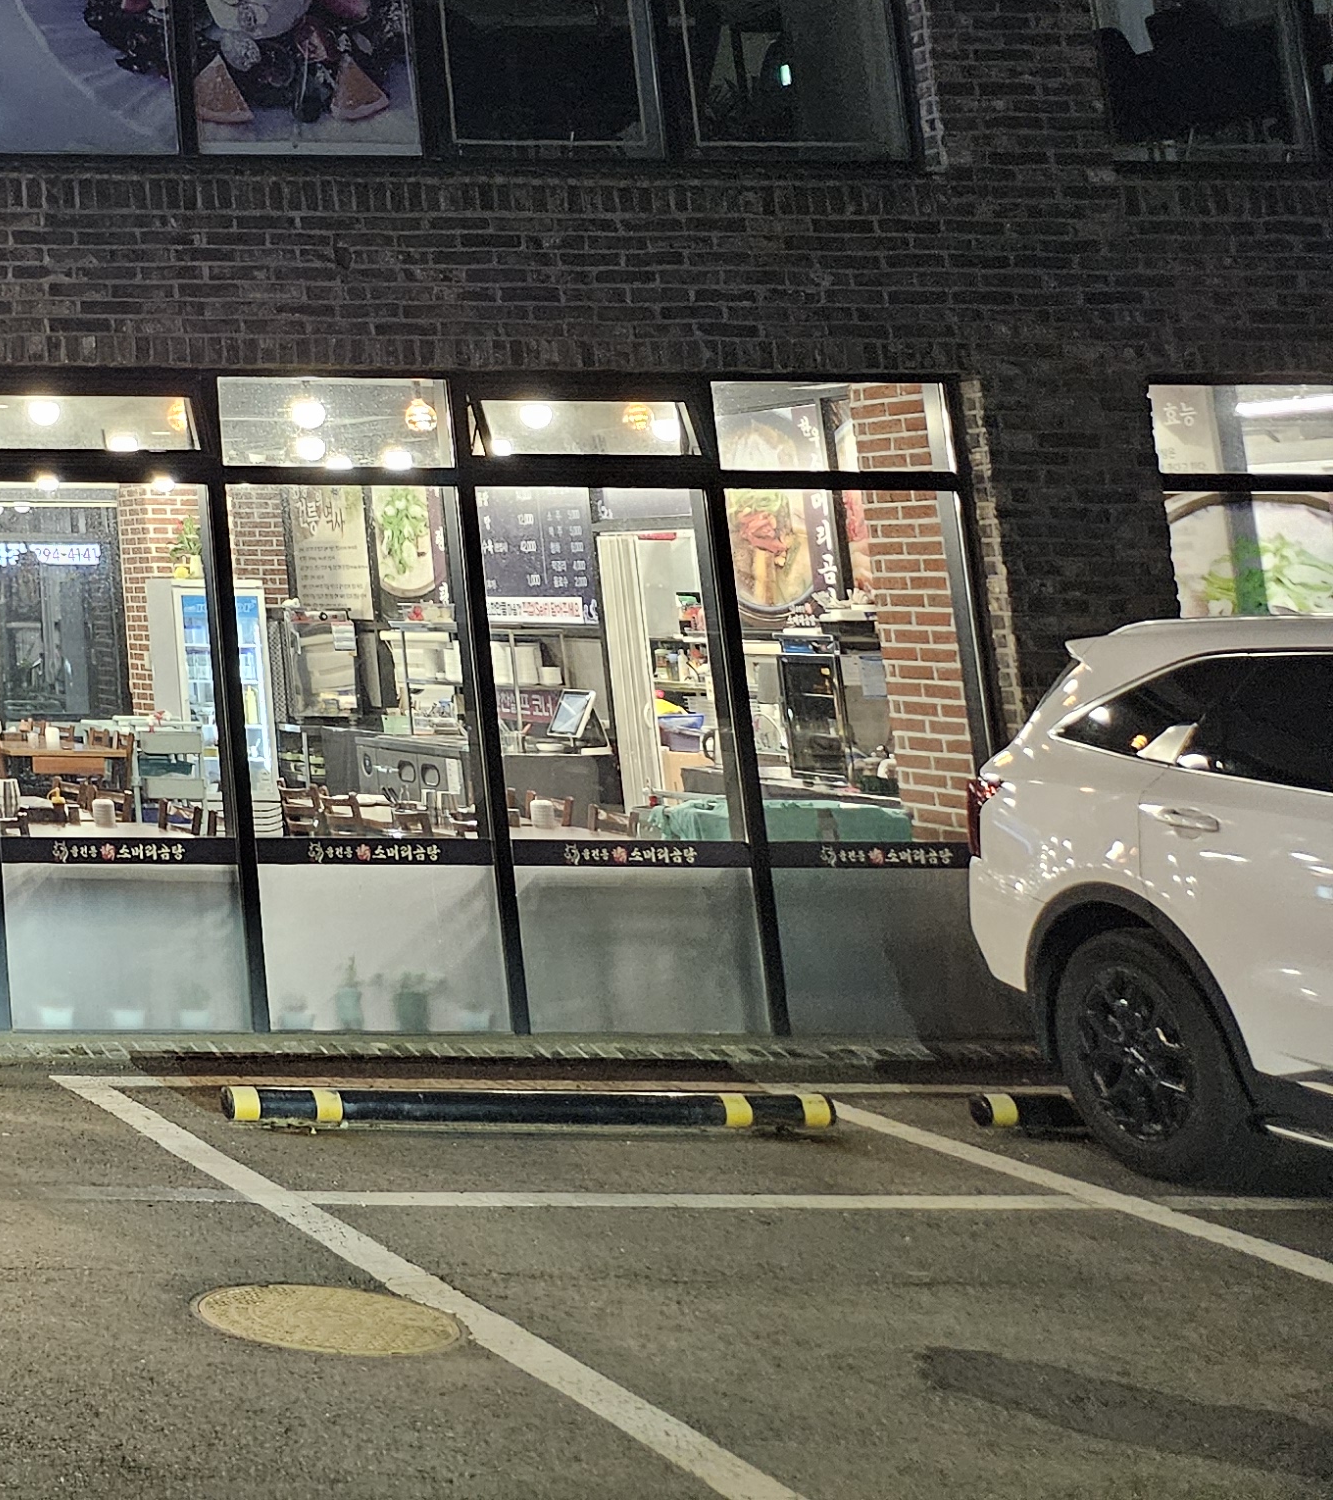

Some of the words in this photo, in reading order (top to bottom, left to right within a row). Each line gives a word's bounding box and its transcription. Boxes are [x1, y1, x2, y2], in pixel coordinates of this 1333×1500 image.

[797, 415, 821, 443] 한우
[810, 453, 839, 601] 머리곰
[116, 843, 186, 860] 소머리곰탕
[372, 844, 441, 861] 소머리곰탕
[628, 846, 698, 864] 소머리곰탕
